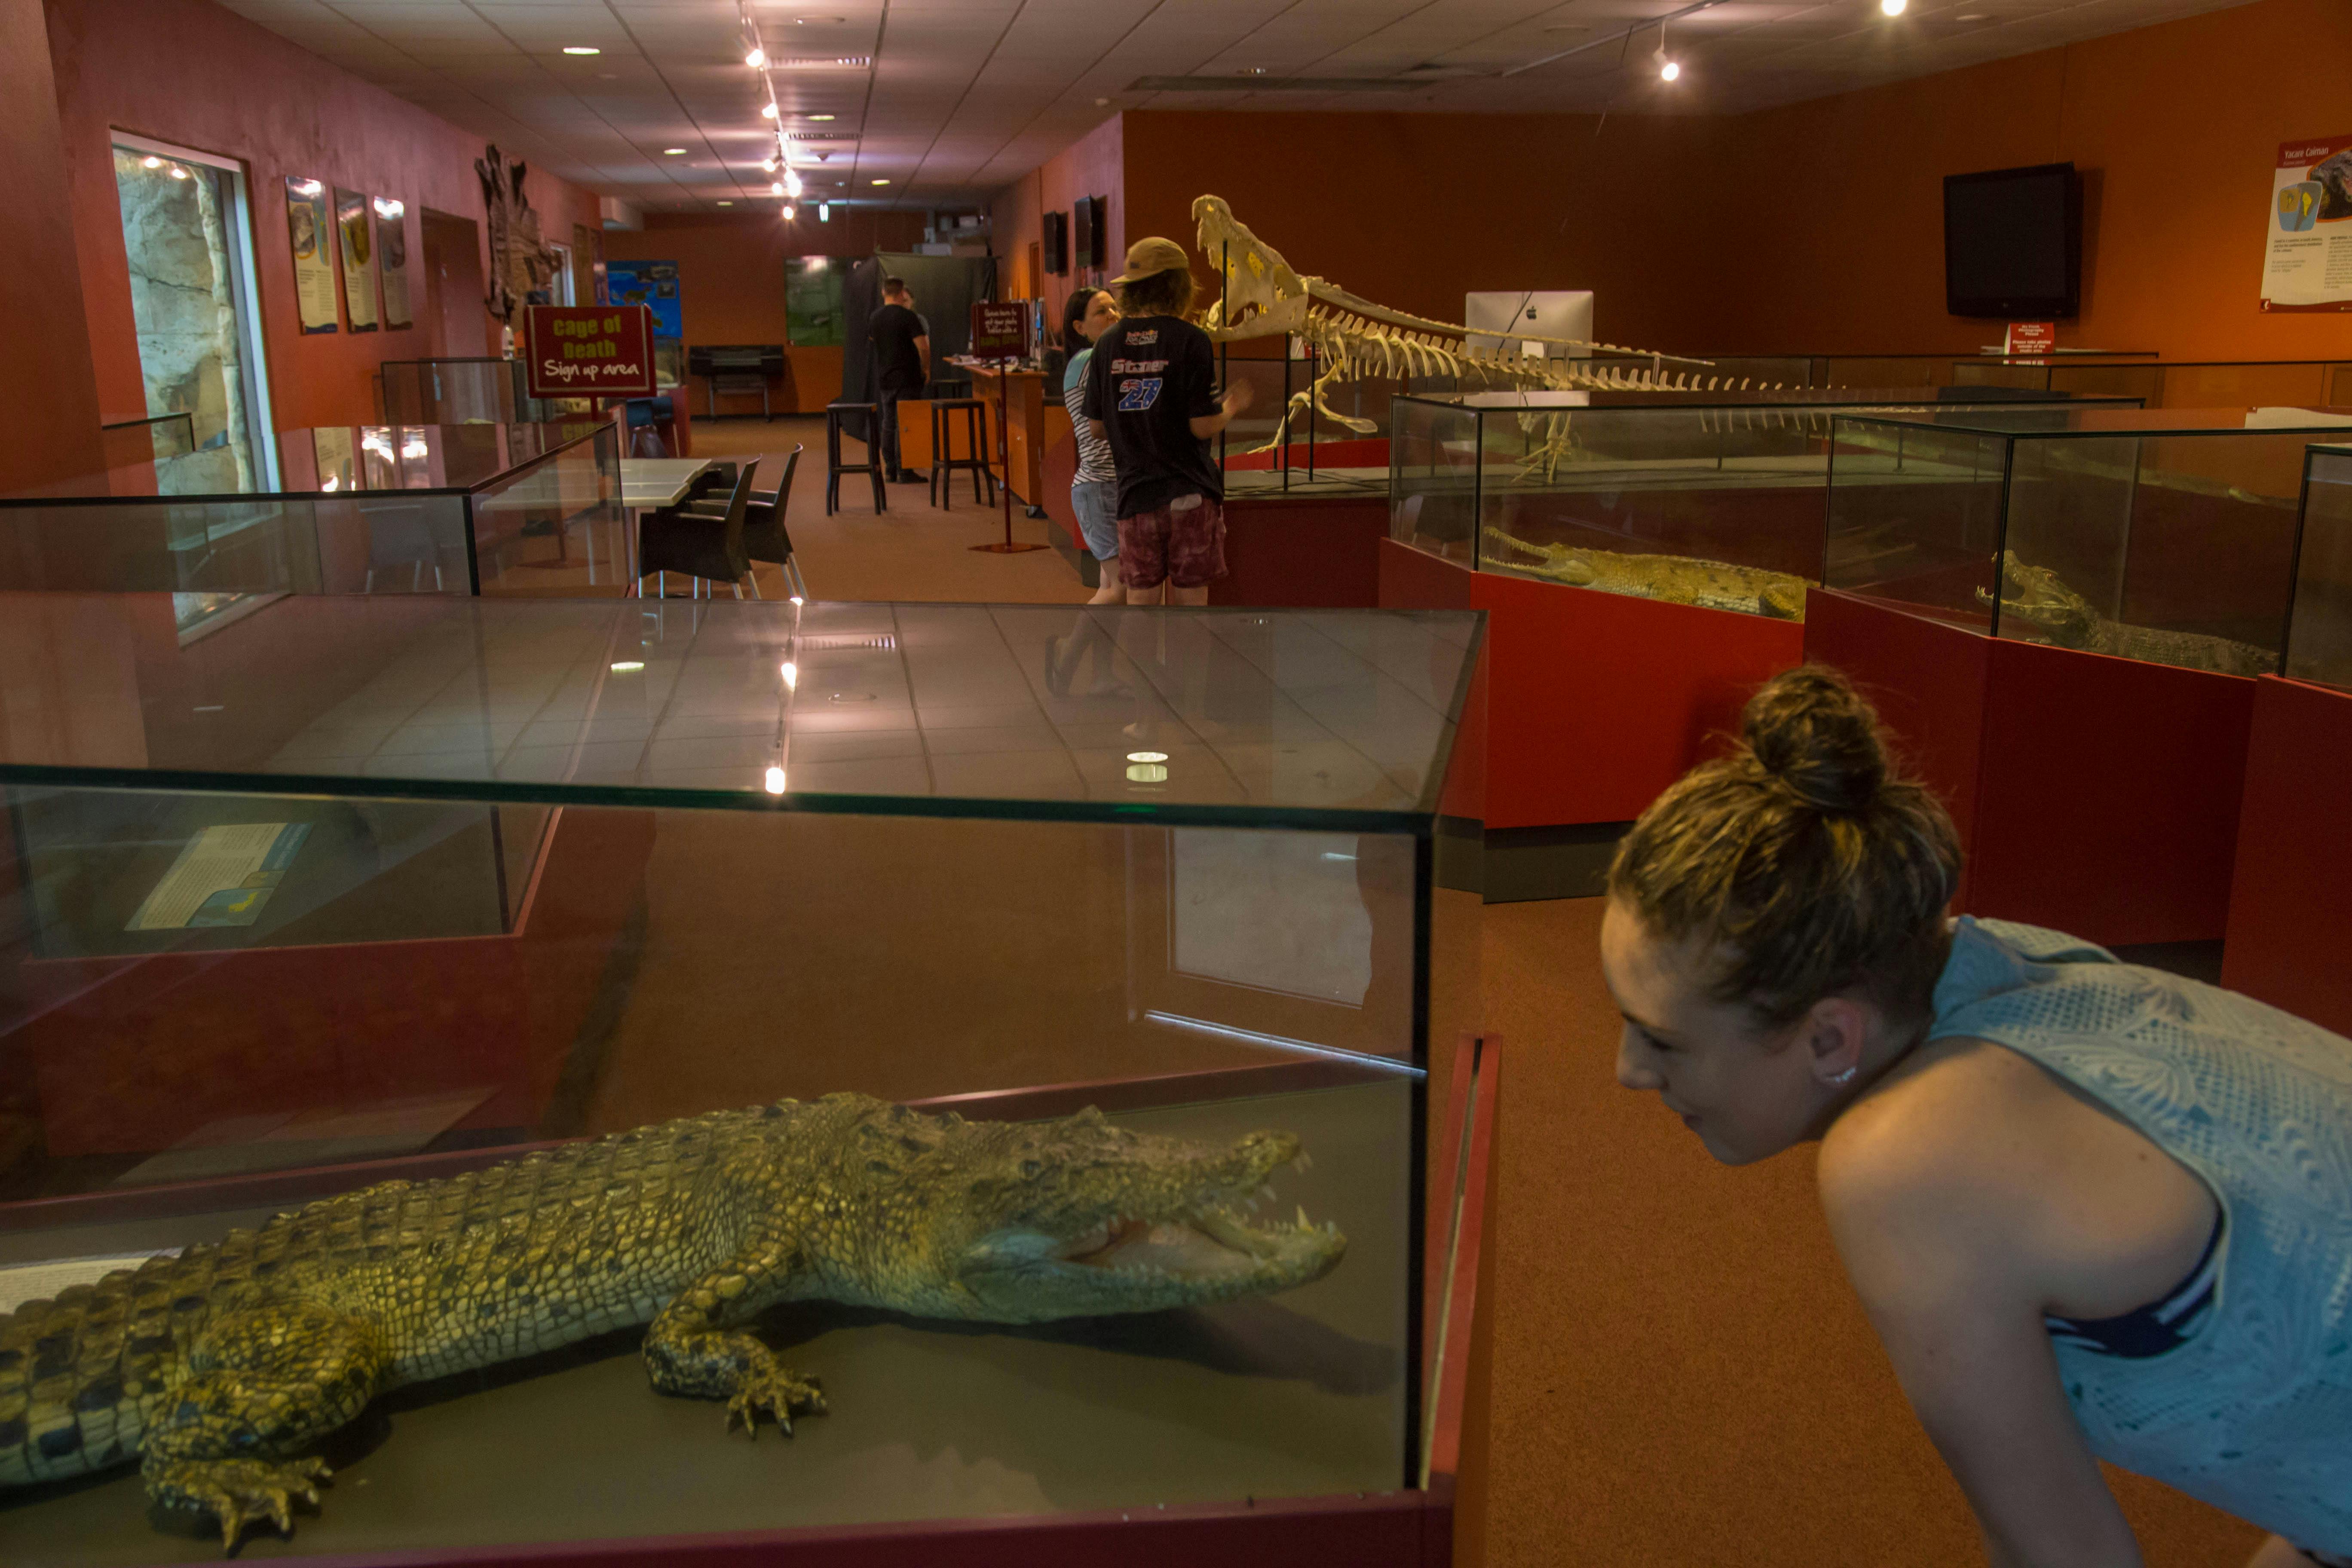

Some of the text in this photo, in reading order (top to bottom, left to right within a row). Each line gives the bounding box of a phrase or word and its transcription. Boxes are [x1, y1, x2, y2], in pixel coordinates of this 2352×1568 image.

[2285, 147, 2328, 159] Yacare Caiman
[603, 314, 621, 334] of
[564, 339, 617, 358] Death
[544, 359, 640, 382] Sign up area
[1118, 378, 1163, 411] 27
